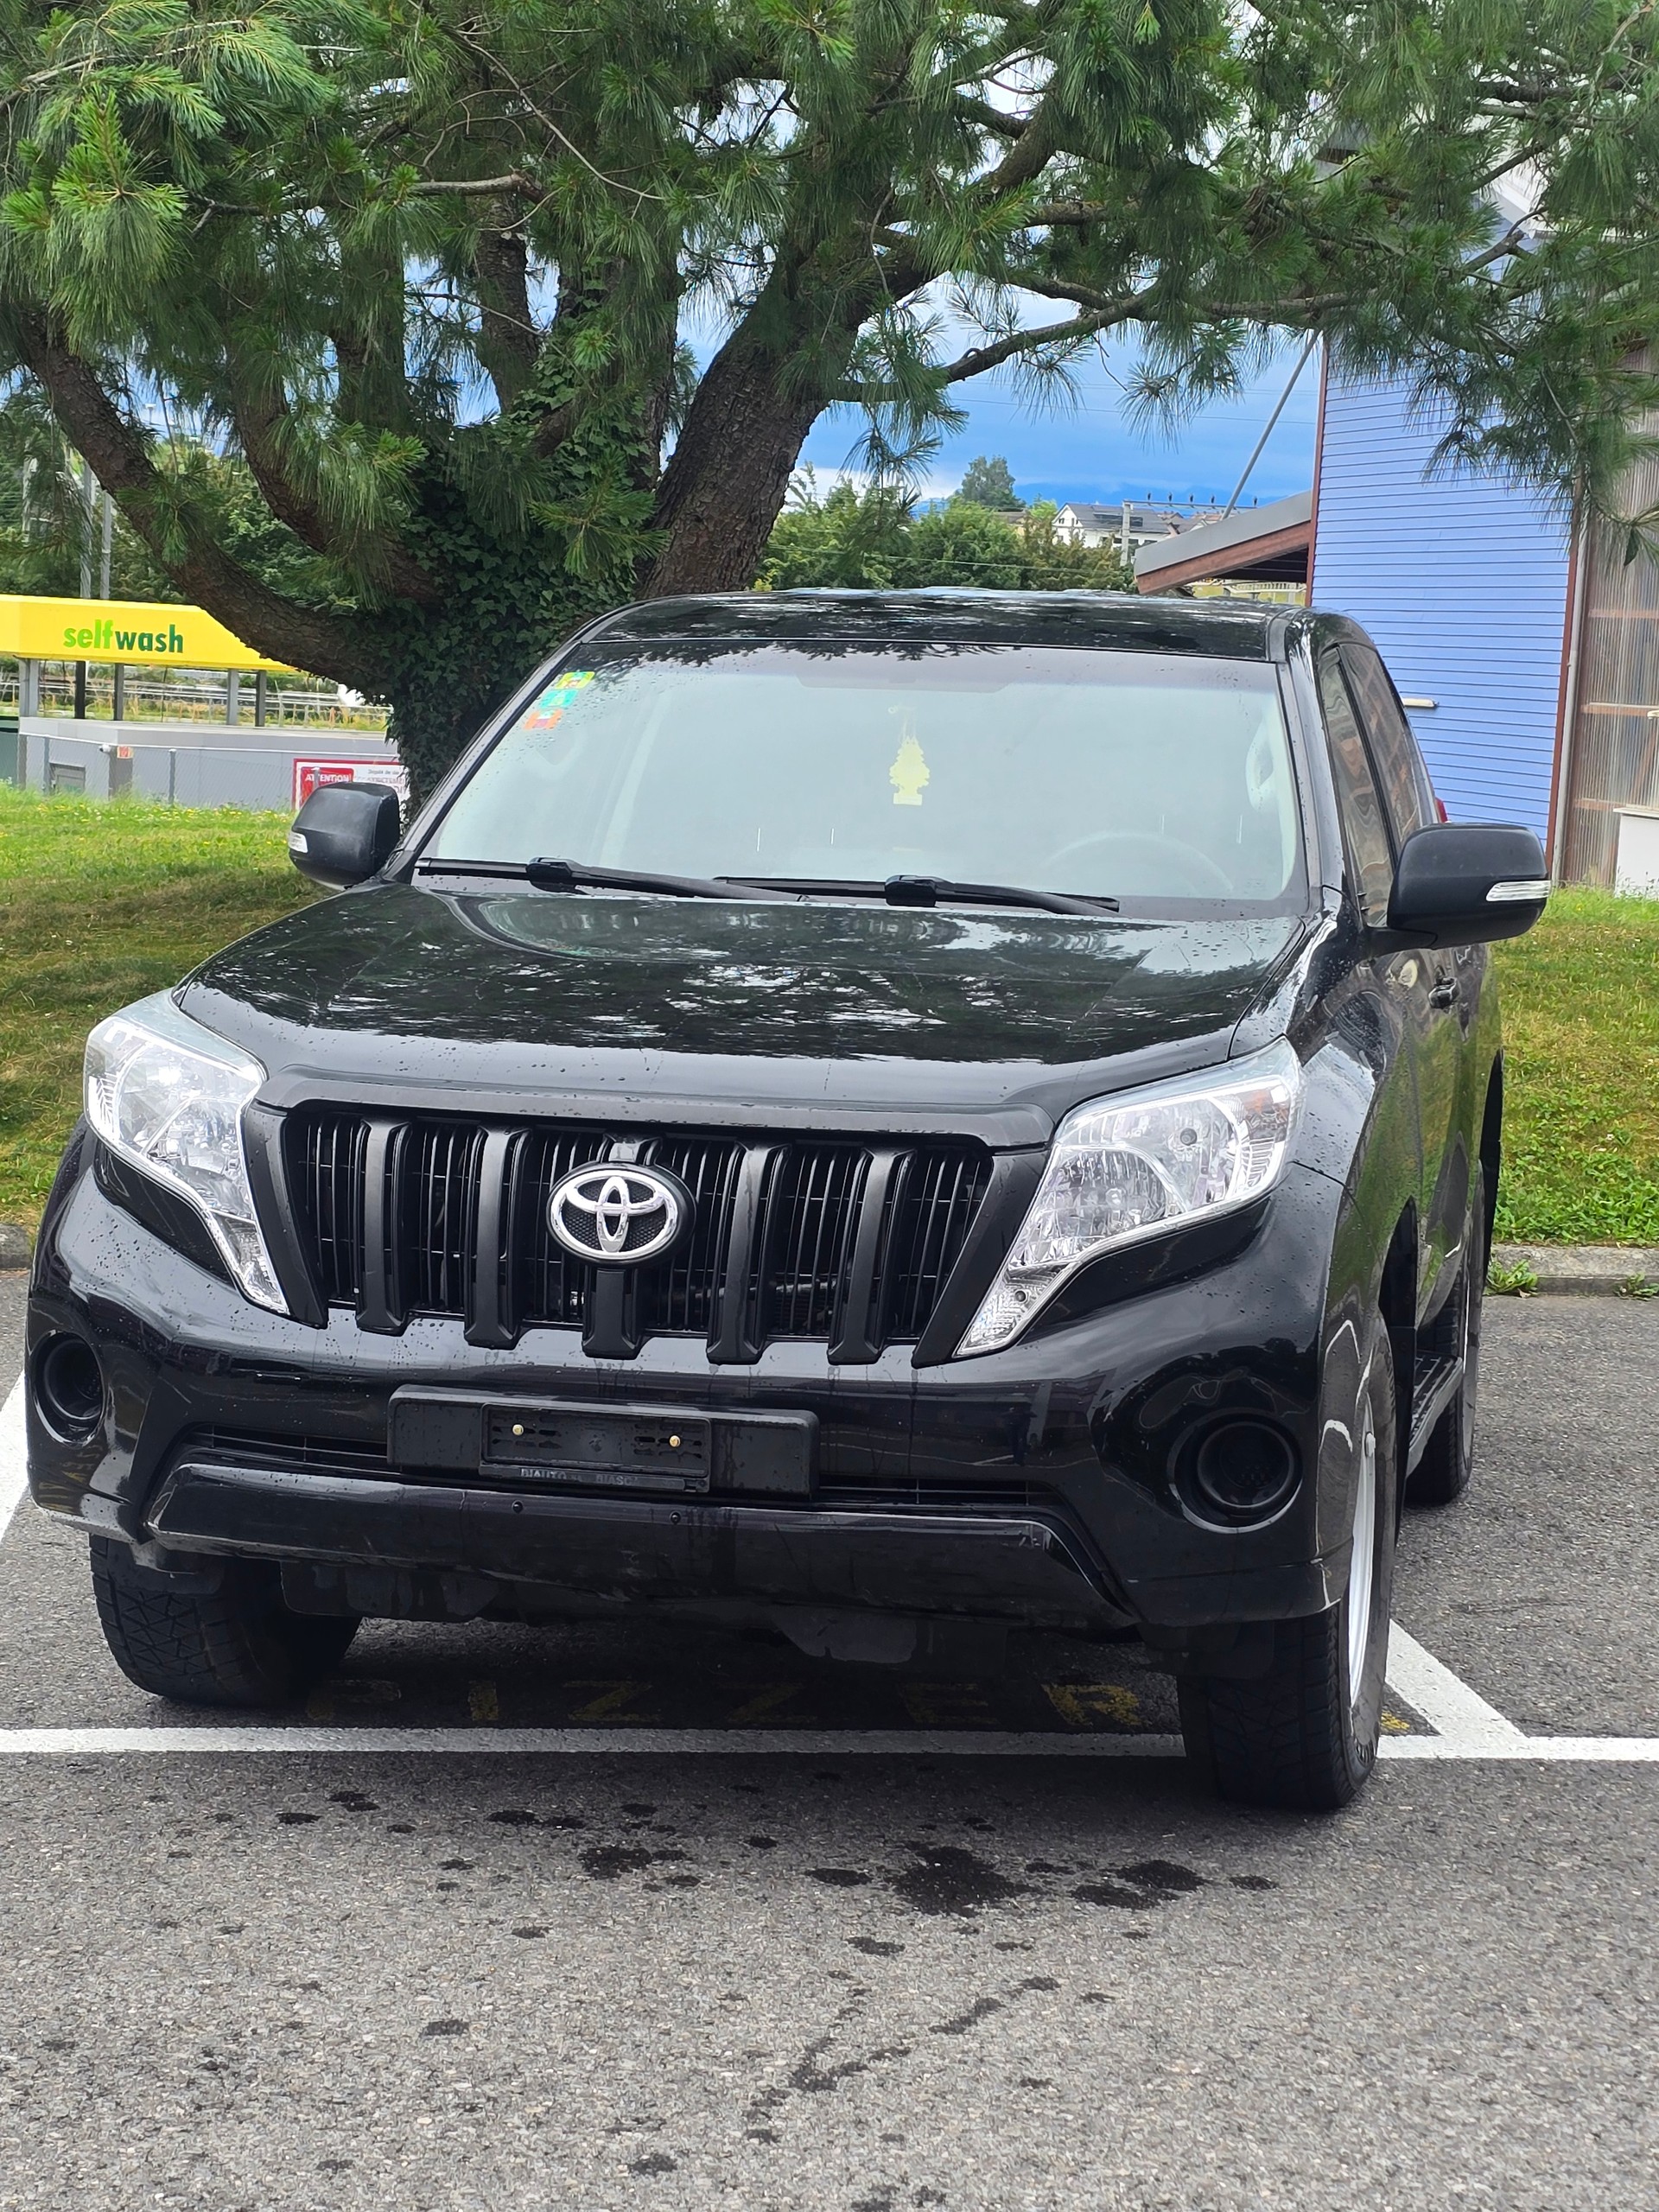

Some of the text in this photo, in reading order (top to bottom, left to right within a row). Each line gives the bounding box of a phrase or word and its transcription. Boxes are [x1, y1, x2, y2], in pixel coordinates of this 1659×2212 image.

[63, 619, 184, 654] selfwash
[304, 773, 352, 783] ATENTION!
[303, 1678, 1410, 1731] PIZZER
